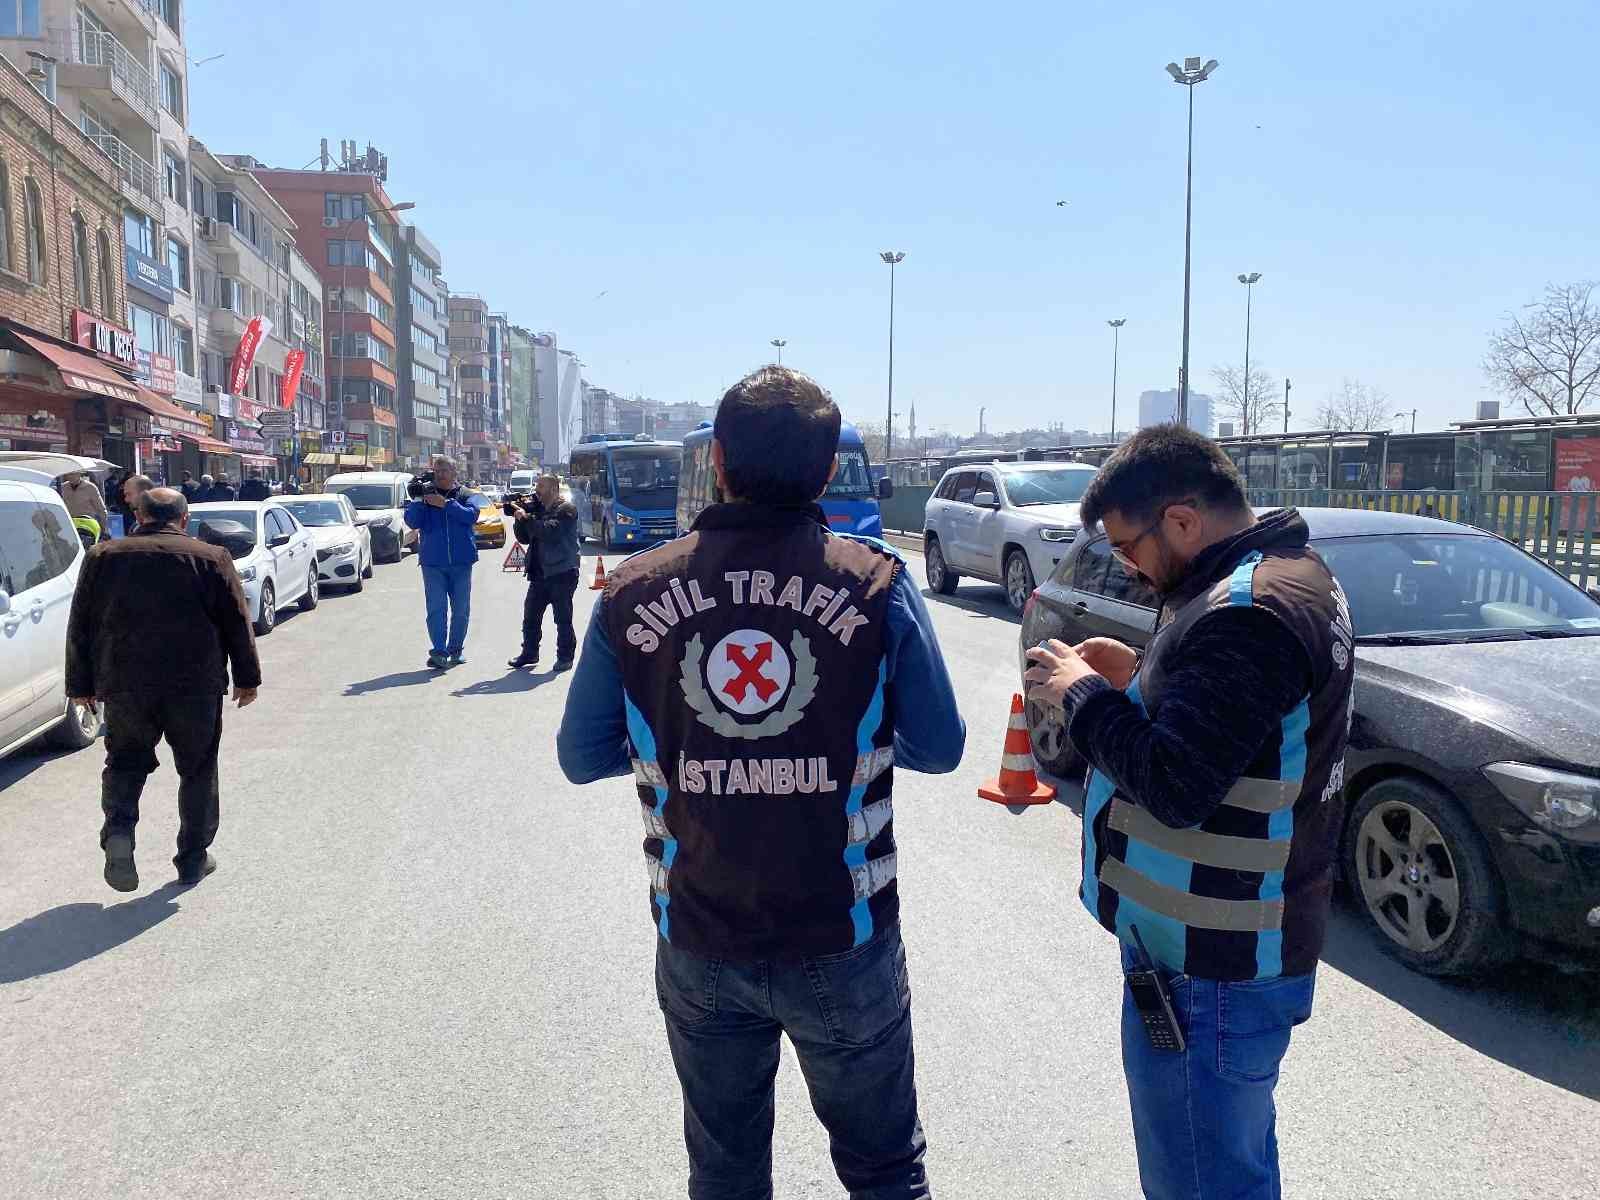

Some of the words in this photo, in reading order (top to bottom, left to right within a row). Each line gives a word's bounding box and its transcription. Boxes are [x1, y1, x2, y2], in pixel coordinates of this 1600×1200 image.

[626, 577, 717, 653] SİVİL
[724, 570, 869, 646] TRAFİK
[678, 750, 838, 795] İSTANBUL
